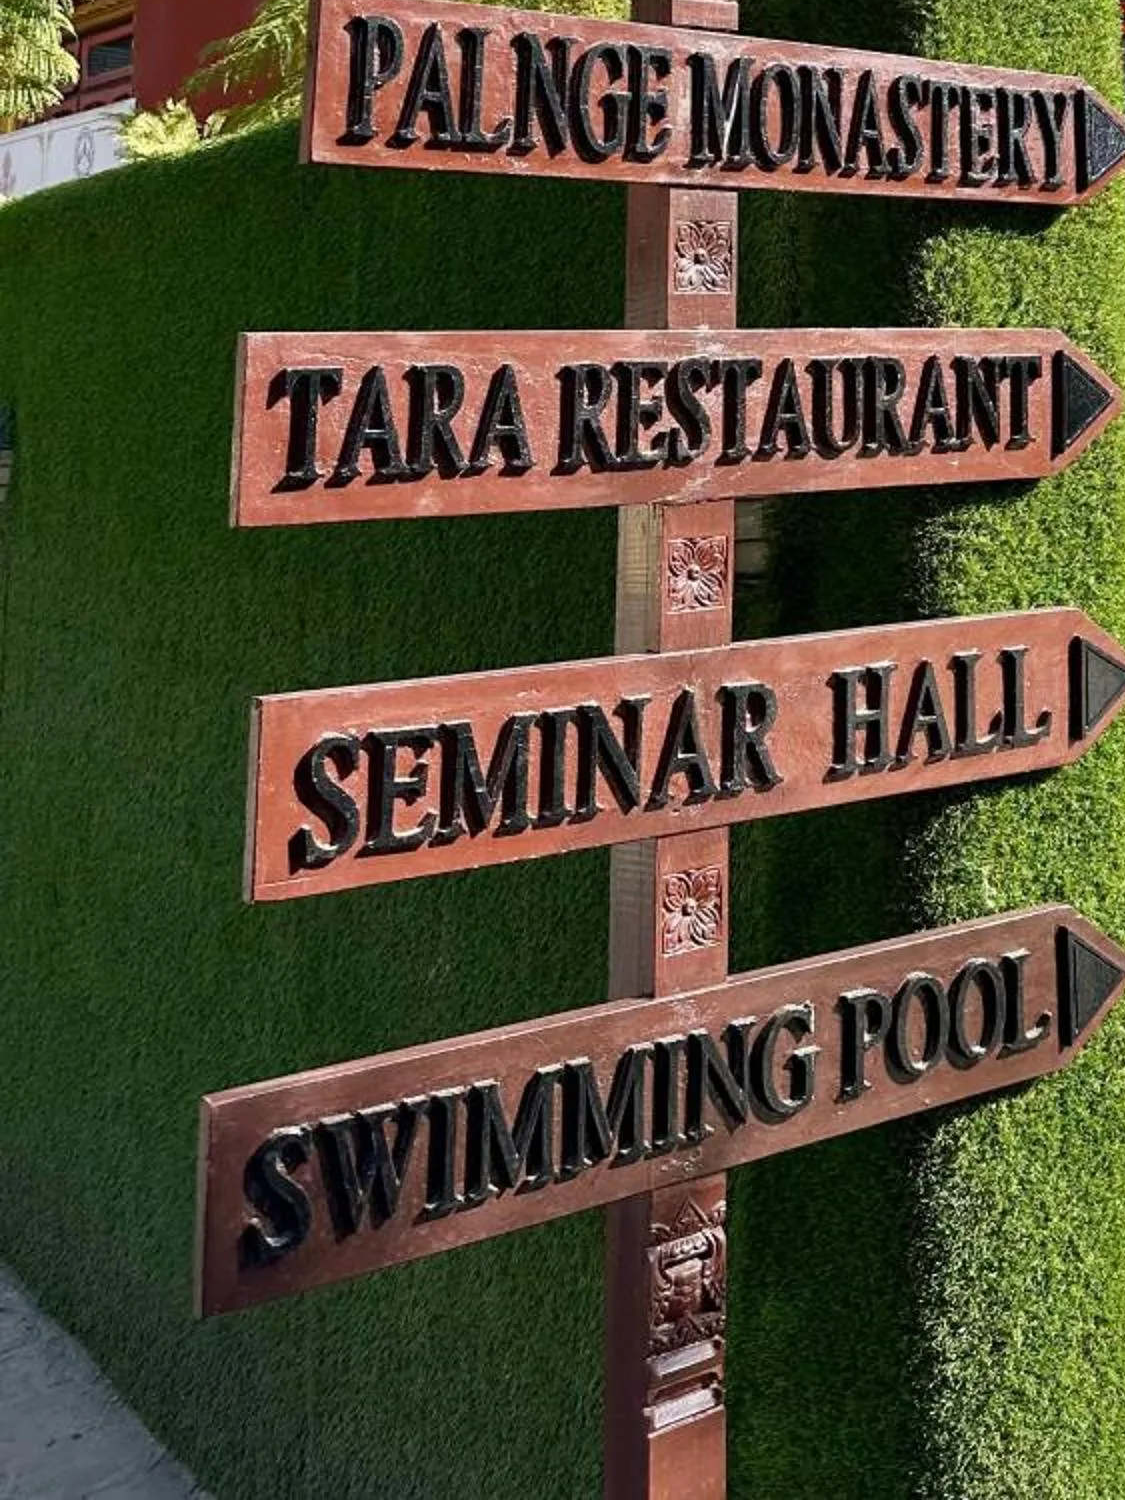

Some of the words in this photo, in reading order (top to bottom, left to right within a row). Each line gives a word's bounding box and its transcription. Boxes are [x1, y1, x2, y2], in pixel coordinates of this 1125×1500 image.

[337, 15, 673, 163] PALNGE
[686, 51, 1068, 193] MONASTERY
[267, 365, 536, 490] TARA
[554, 354, 1041, 471] RESTAURANT
[290, 684, 784, 873] SEMINAR
[826, 646, 1052, 781] HALL
[240, 1002, 818, 1269] SWIMMING
[836, 949, 1052, 1098] POOL
